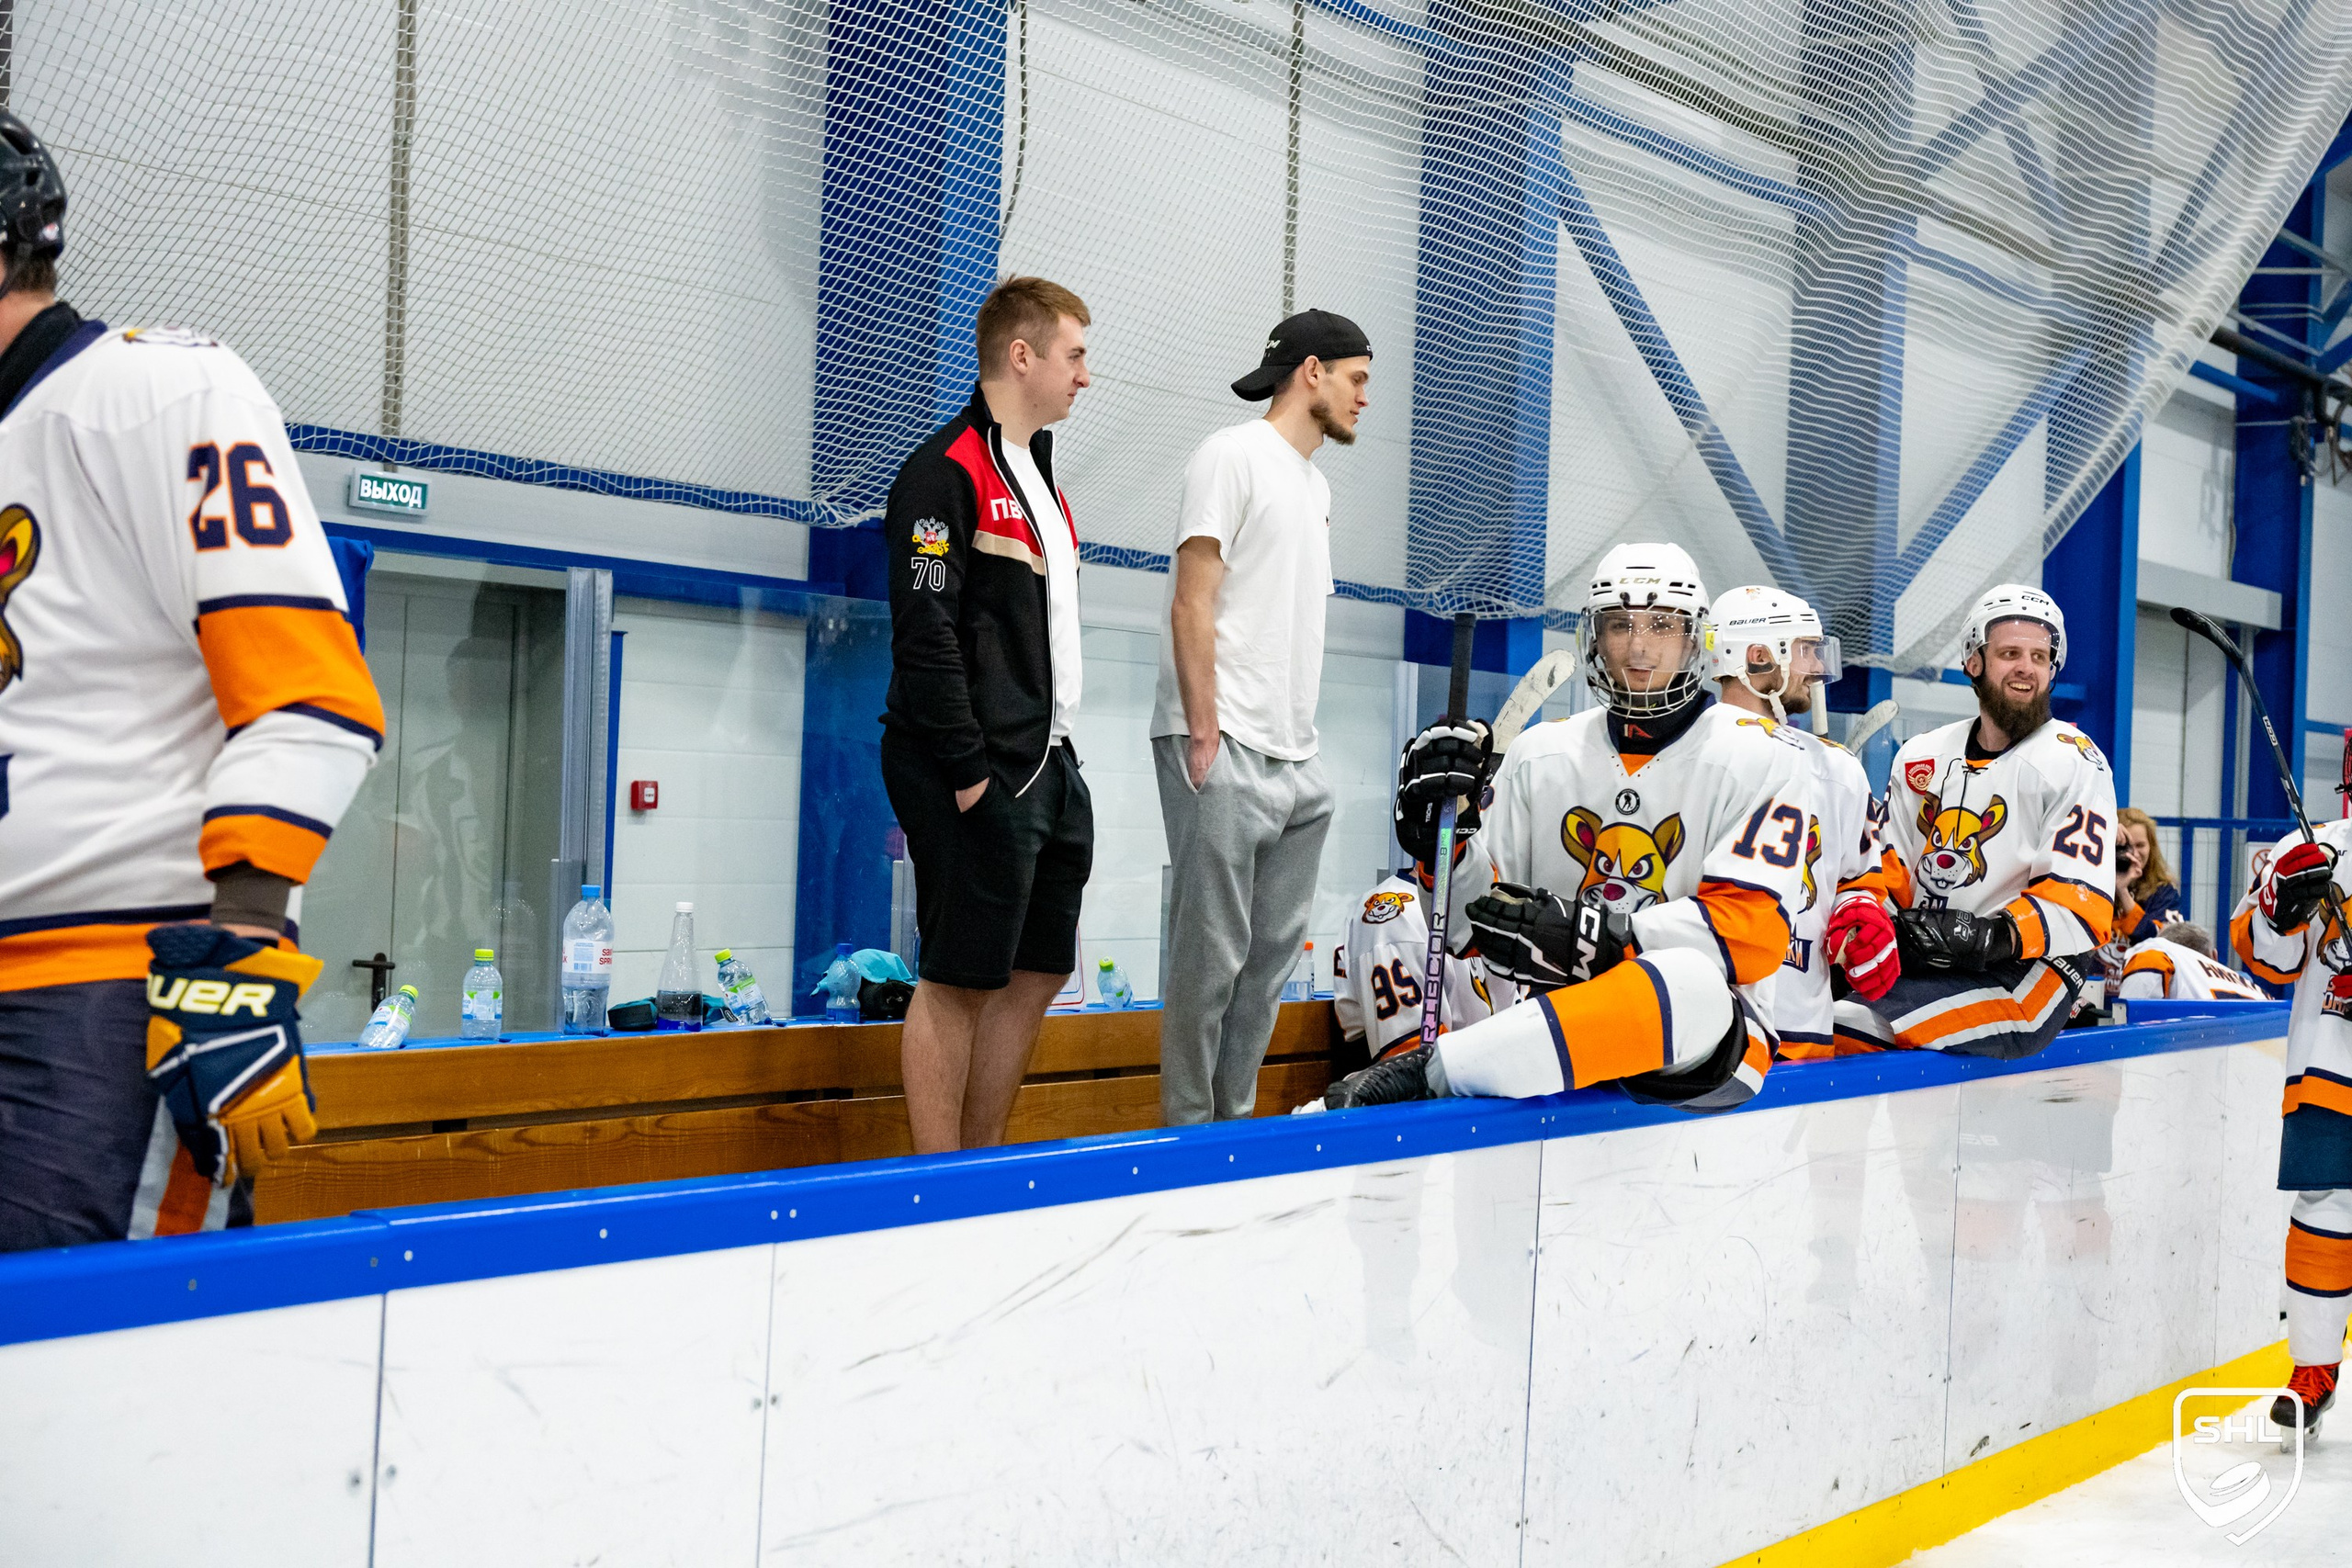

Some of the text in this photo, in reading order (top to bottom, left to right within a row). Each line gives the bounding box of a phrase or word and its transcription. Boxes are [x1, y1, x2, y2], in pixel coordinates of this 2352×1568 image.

[187, 441, 295, 551] 26
[360, 479, 422, 508] ВЫХОД
[911, 557, 946, 592] 70
[1619, 577, 1661, 585] CCM
[2021, 594, 2050, 606] CCM
[1731, 796, 1804, 869] 13
[2052, 804, 2107, 867] 25
[1571, 904, 1600, 982] CM
[147, 973, 277, 1017] UER
[1371, 958, 1423, 1021] 95
[1421, 912, 1446, 1044] RIBCOR
